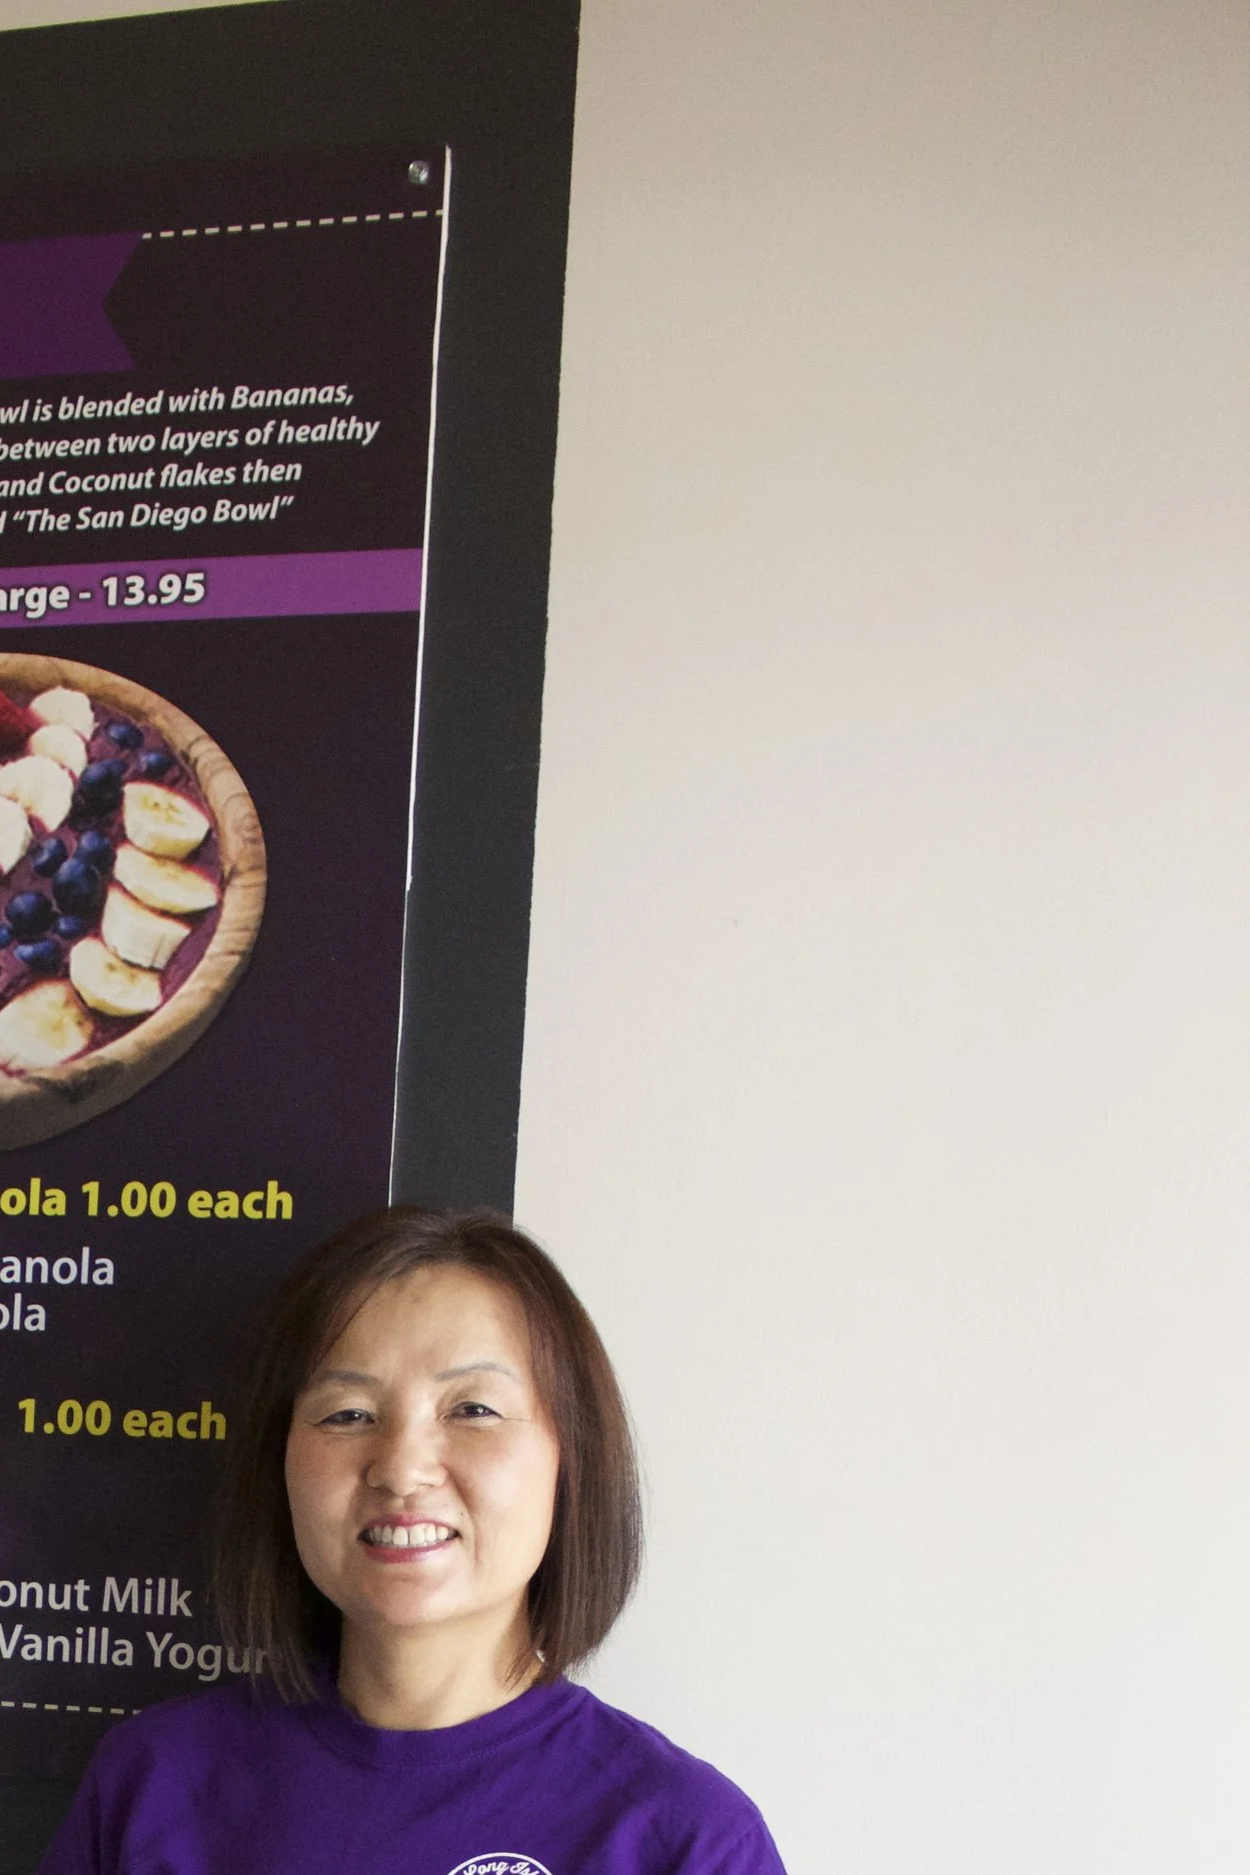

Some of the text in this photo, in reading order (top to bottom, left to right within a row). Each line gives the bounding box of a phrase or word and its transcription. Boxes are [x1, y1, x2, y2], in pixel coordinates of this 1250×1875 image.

[33, 399, 52, 421] is
[58, 390, 164, 420] blended
[169, 387, 225, 412] with
[231, 385, 353, 409] Bananas,
[108, 433, 155, 453] two
[161, 427, 239, 455] layers
[245, 420, 276, 445] of
[278, 416, 380, 445] healthy
[49, 468, 155, 494] Coconut
[160, 462, 236, 487] flakes
[243, 459, 302, 483] then
[76, 507, 124, 529] San
[130, 503, 207, 531] Diego
[103, 573, 204, 605] 13.95
[82, 1181, 176, 1217] 1.00
[188, 1181, 292, 1219] each
[19, 1399, 111, 1435] 1.00
[123, 1402, 225, 1439] each
[103, 1577, 192, 1616] Milk
[145, 1631, 269, 1682] Yogur
